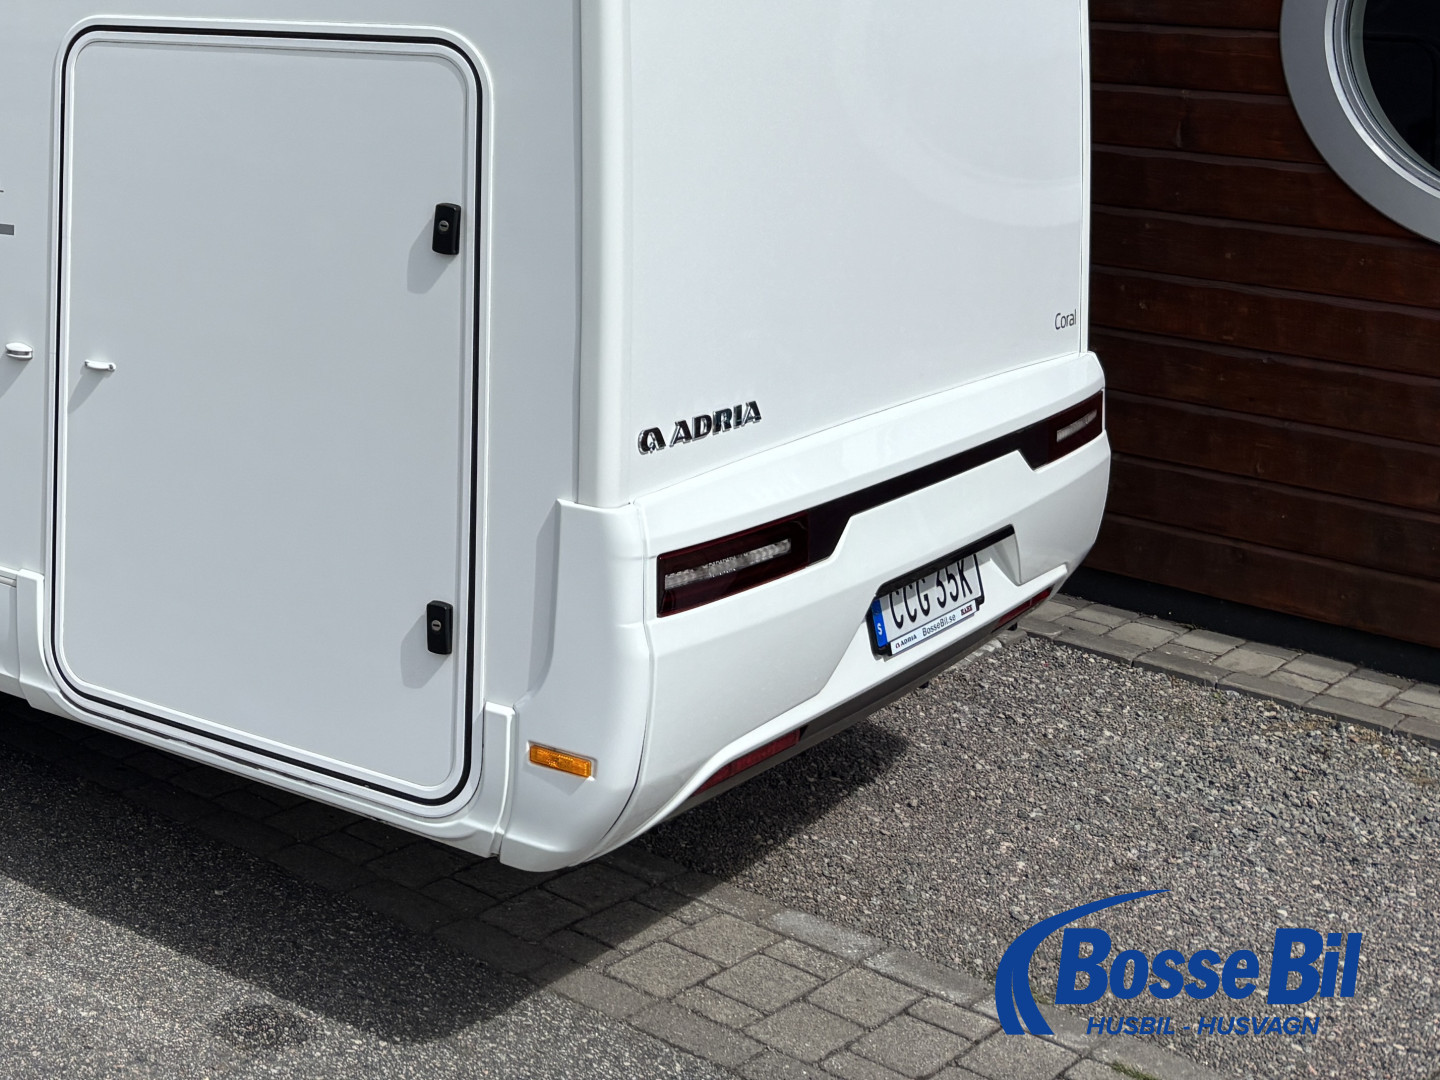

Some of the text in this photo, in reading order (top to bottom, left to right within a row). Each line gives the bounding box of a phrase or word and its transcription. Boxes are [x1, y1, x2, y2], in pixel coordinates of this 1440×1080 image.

[1054, 308, 1077, 330] Coral
[669, 400, 762, 448] ADRIA
[887, 578, 931, 629] CCG
[876, 622, 883, 636] S
[921, 614, 957, 637] BosseBil.se
